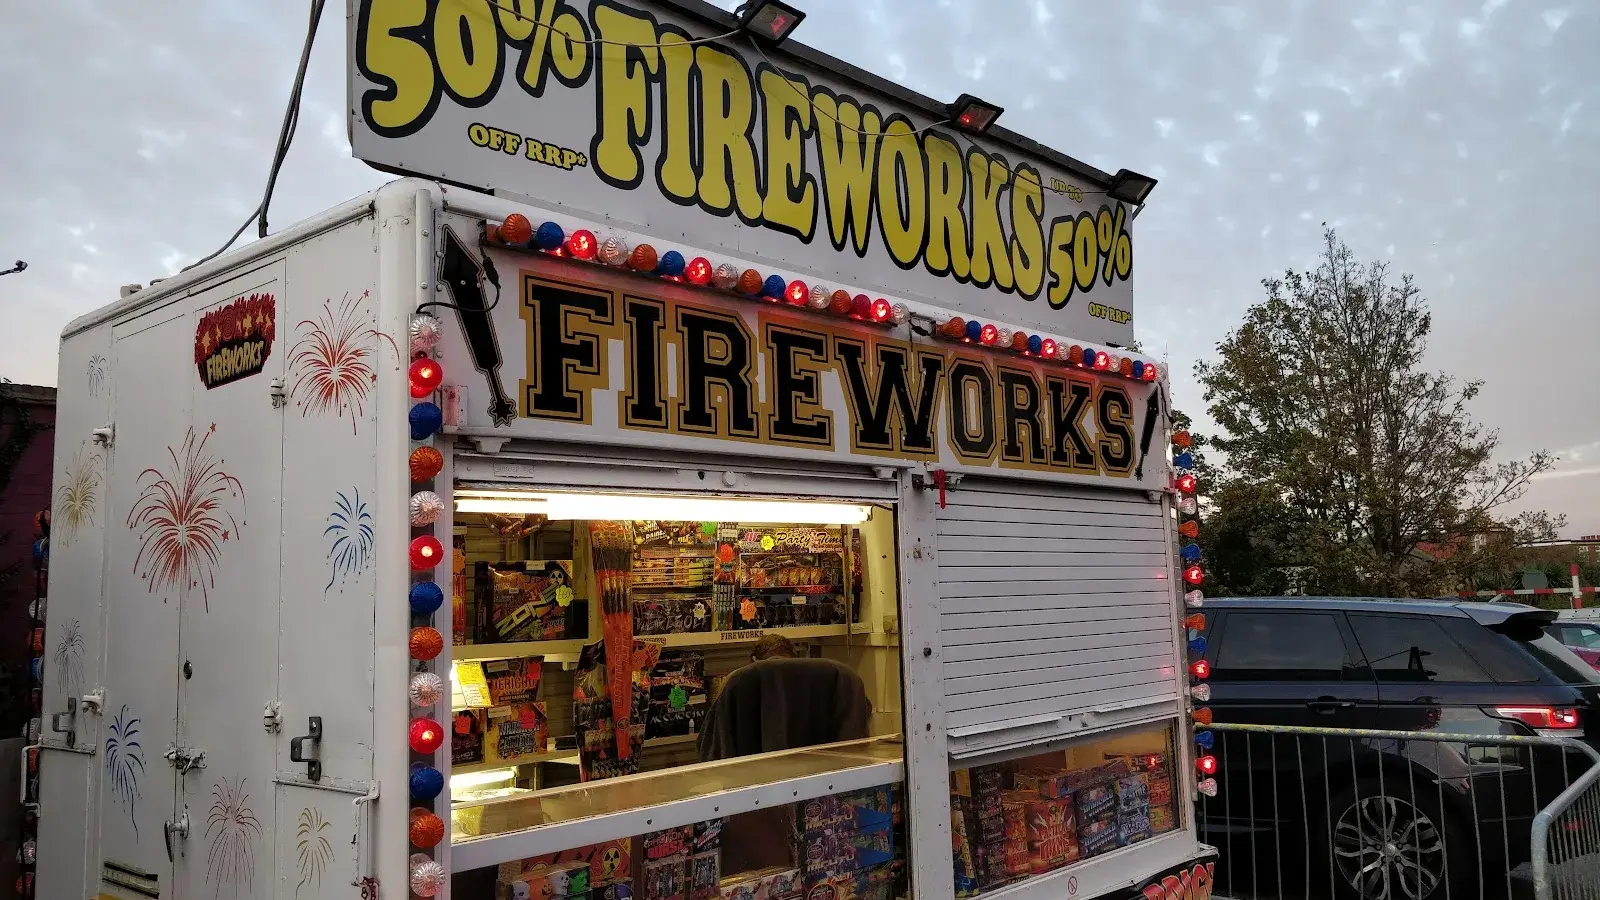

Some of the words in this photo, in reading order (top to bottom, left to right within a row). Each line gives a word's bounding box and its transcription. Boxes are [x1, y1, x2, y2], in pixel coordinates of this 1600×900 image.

[356, 0, 593, 138] 50%
[468, 122, 522, 152] OFF
[589, 0, 1044, 301] FIREWORKS
[1050, 177, 1066, 195] UP
[1067, 183, 1084, 203] TO
[1047, 200, 1132, 310] 50%
[1087, 301, 1107, 319] OFF
[206, 340, 264, 385] FIREWORKS
[519, 268, 1136, 478] FIREWORKS
[775, 531, 811, 547] Party
[720, 630, 763, 640] FIREWORKS
